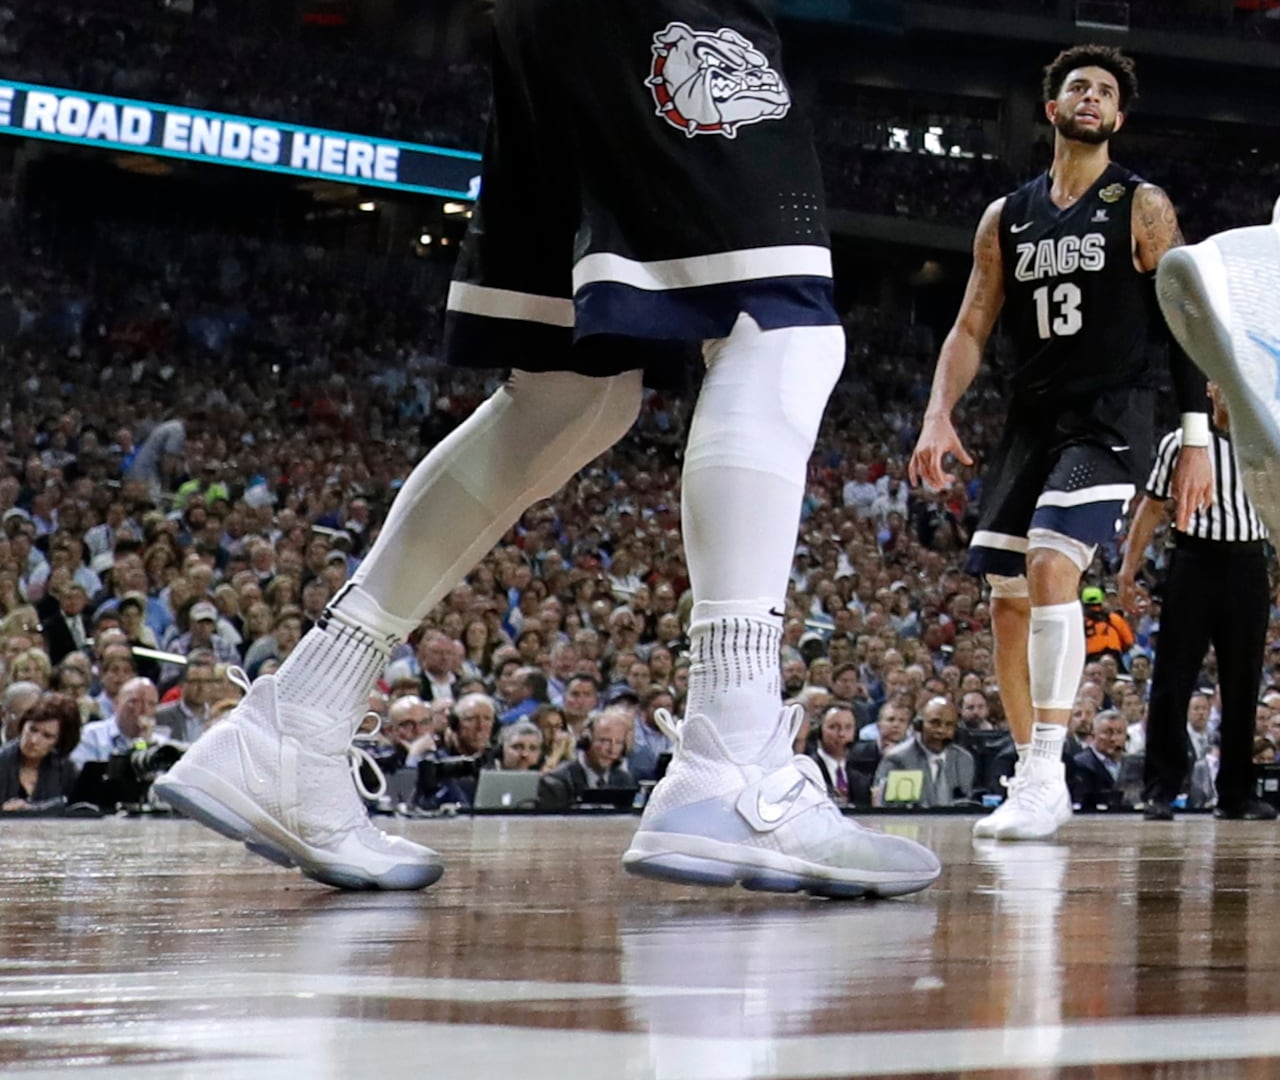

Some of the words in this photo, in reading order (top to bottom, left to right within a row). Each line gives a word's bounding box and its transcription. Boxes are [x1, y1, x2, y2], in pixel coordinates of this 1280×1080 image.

[23, 91, 153, 146] ROAD
[161, 114, 282, 165] ENDS
[290, 133, 400, 183] HERE
[1014, 233, 1106, 282] ZAGS
[1033, 283, 1083, 340] 13
